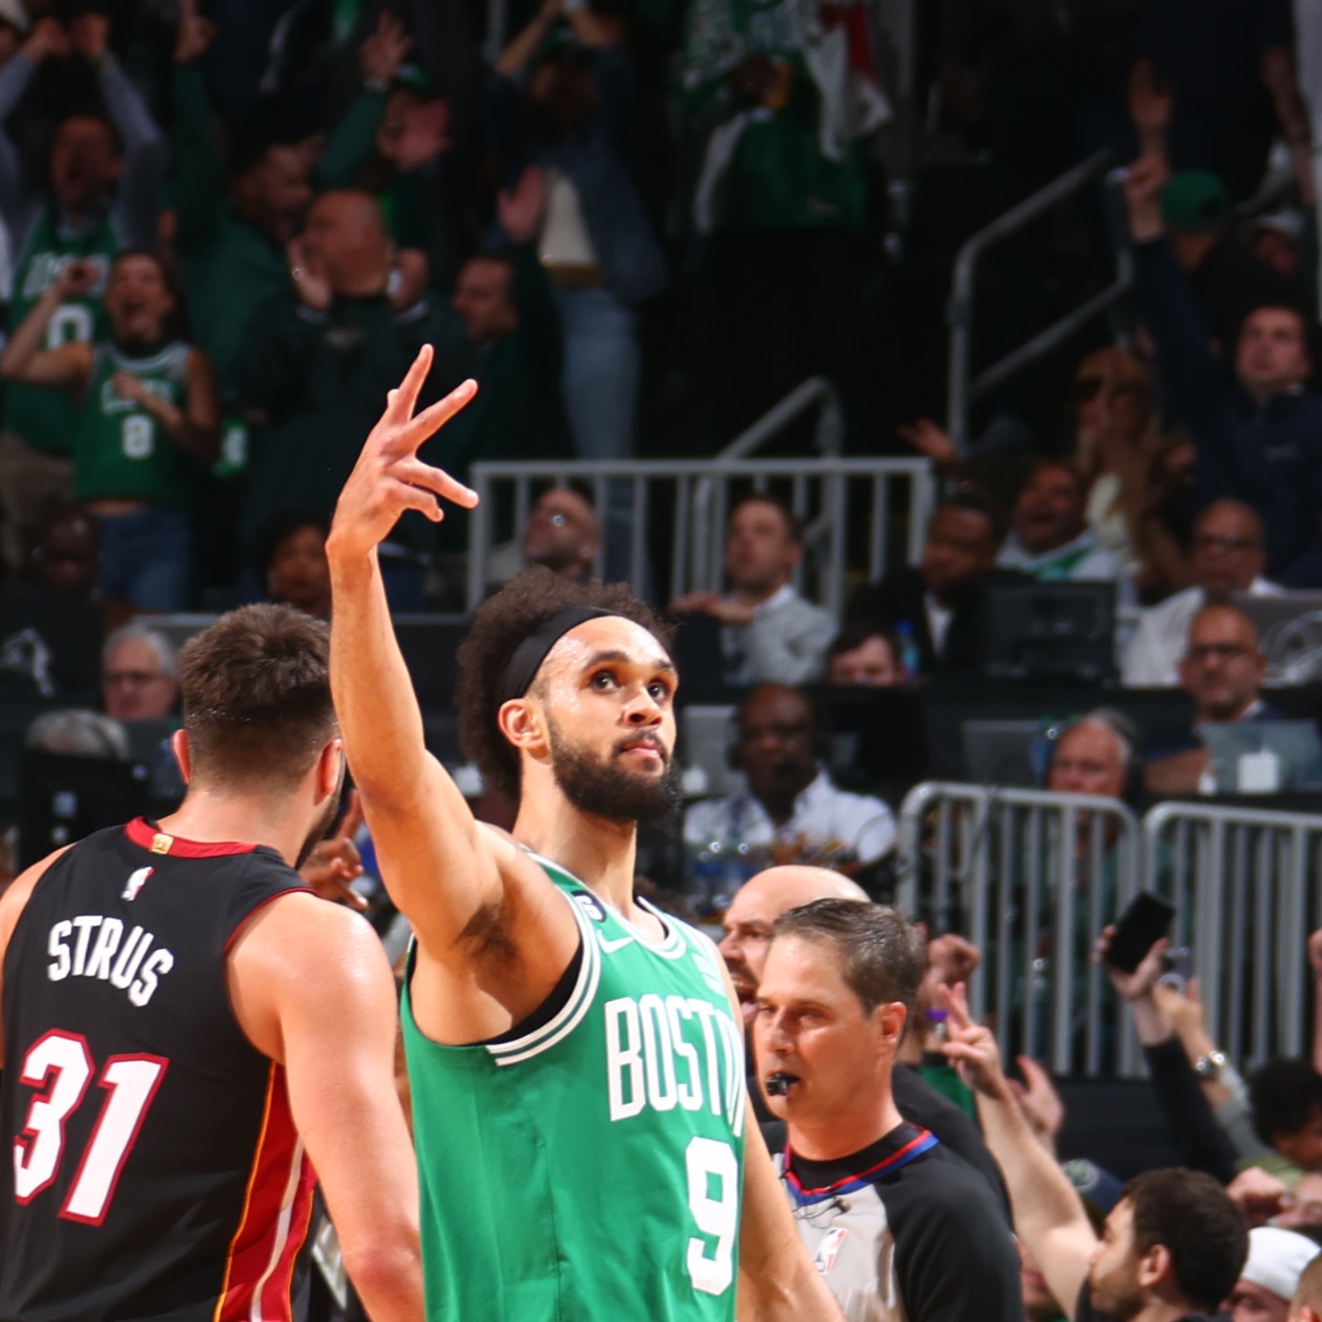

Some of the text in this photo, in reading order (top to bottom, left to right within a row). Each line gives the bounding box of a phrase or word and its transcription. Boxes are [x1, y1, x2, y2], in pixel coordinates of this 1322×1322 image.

[121, 413, 156, 462] 8
[46, 913, 174, 1008] STRUS
[12, 1026, 171, 1228] 31
[685, 1135, 739, 1296] 9
